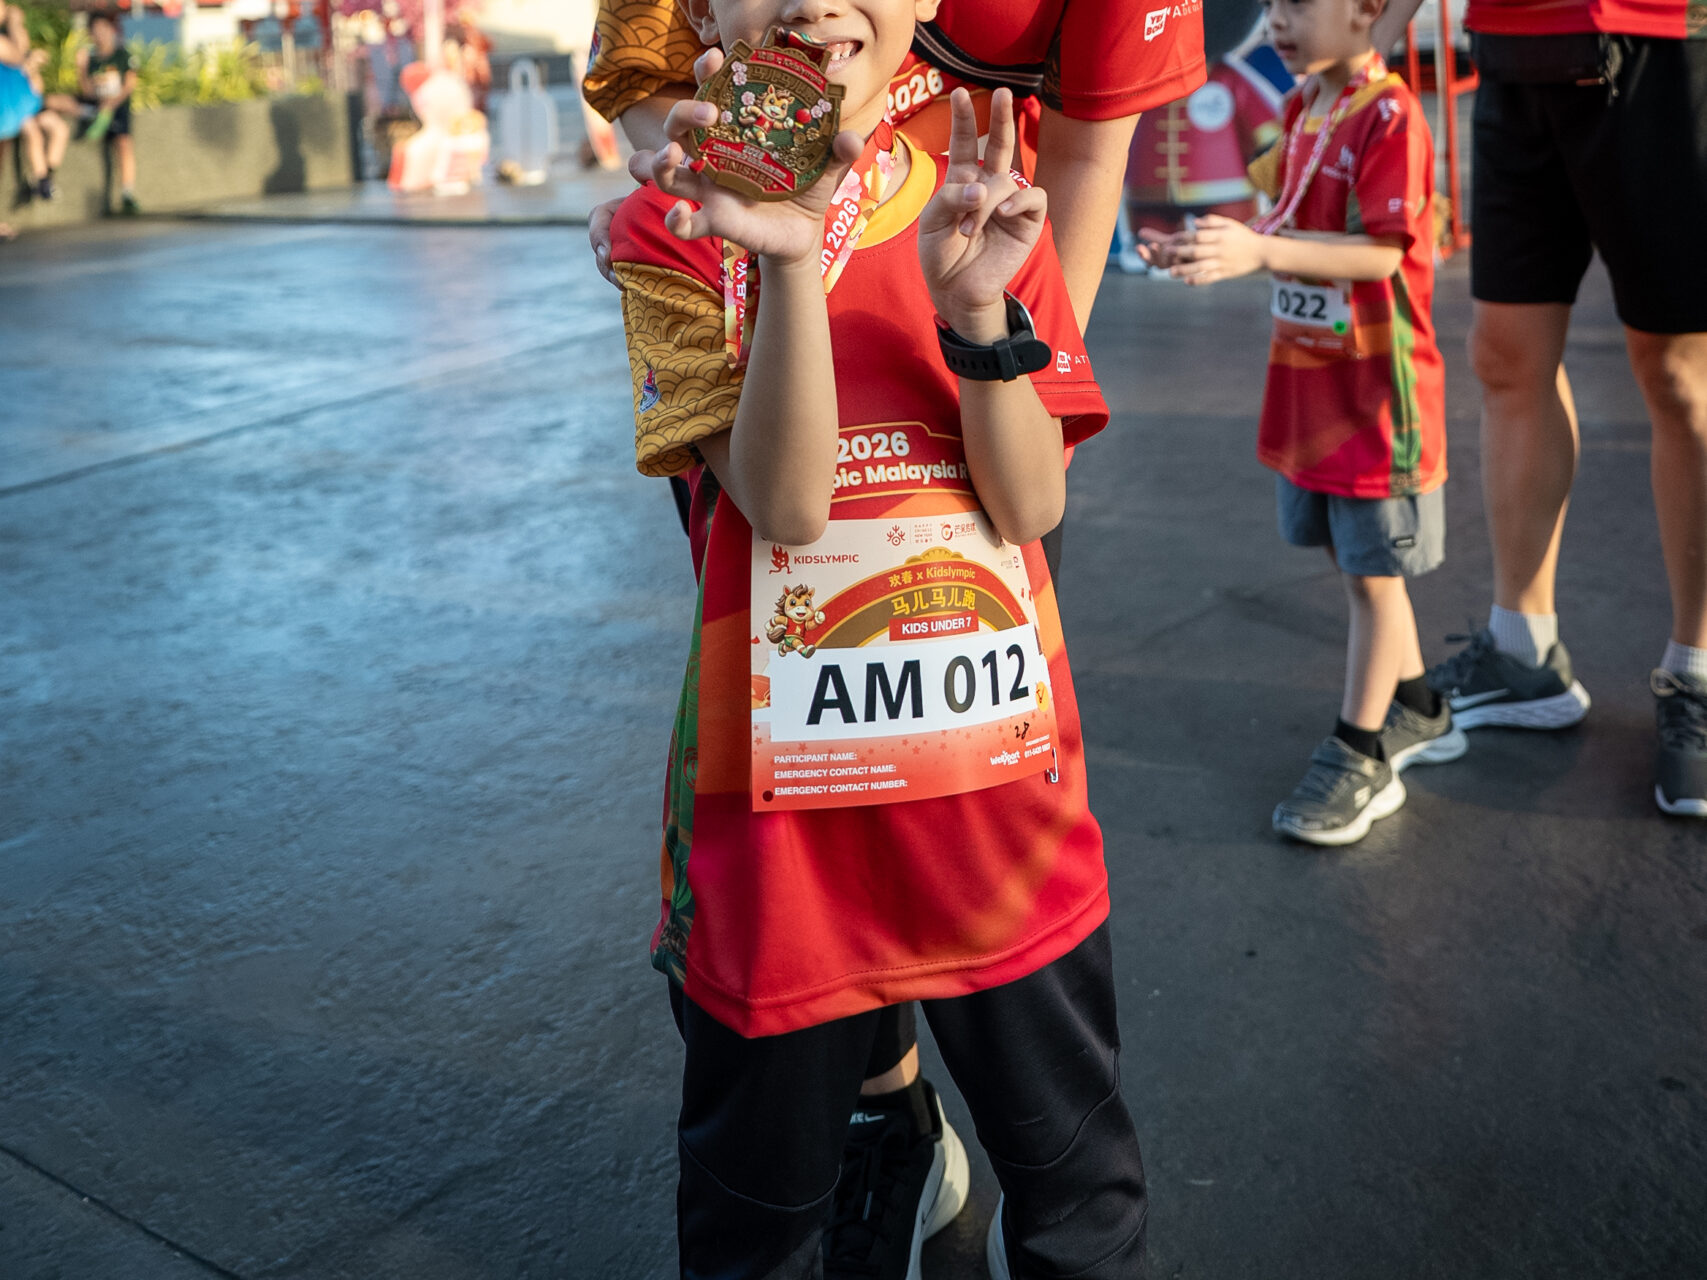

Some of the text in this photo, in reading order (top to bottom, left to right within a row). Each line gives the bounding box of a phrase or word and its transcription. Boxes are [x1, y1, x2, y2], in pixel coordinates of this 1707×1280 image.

[717, 157, 774, 189] FINISHER
[826, 200, 859, 250] 2026
[1278, 287, 1327, 320] 022
[836, 431, 910, 463] 2026
[864, 459, 958, 485] Malaysia
[793, 553, 860, 565] KIDSLYMPIC
[926, 565, 976, 580] Kidslympic
[891, 587, 976, 616] 马儿马儿跑
[902, 616, 972, 635] KIDS UNDER 7
[806, 643, 1030, 726] AM 012
[774, 752, 858, 764] PARTICIPANT NAME:
[774, 764, 897, 779] EMERGENCY CONTACT NAME:
[774, 779, 908, 796] EMERGENCY CONTACT NUMBER:
